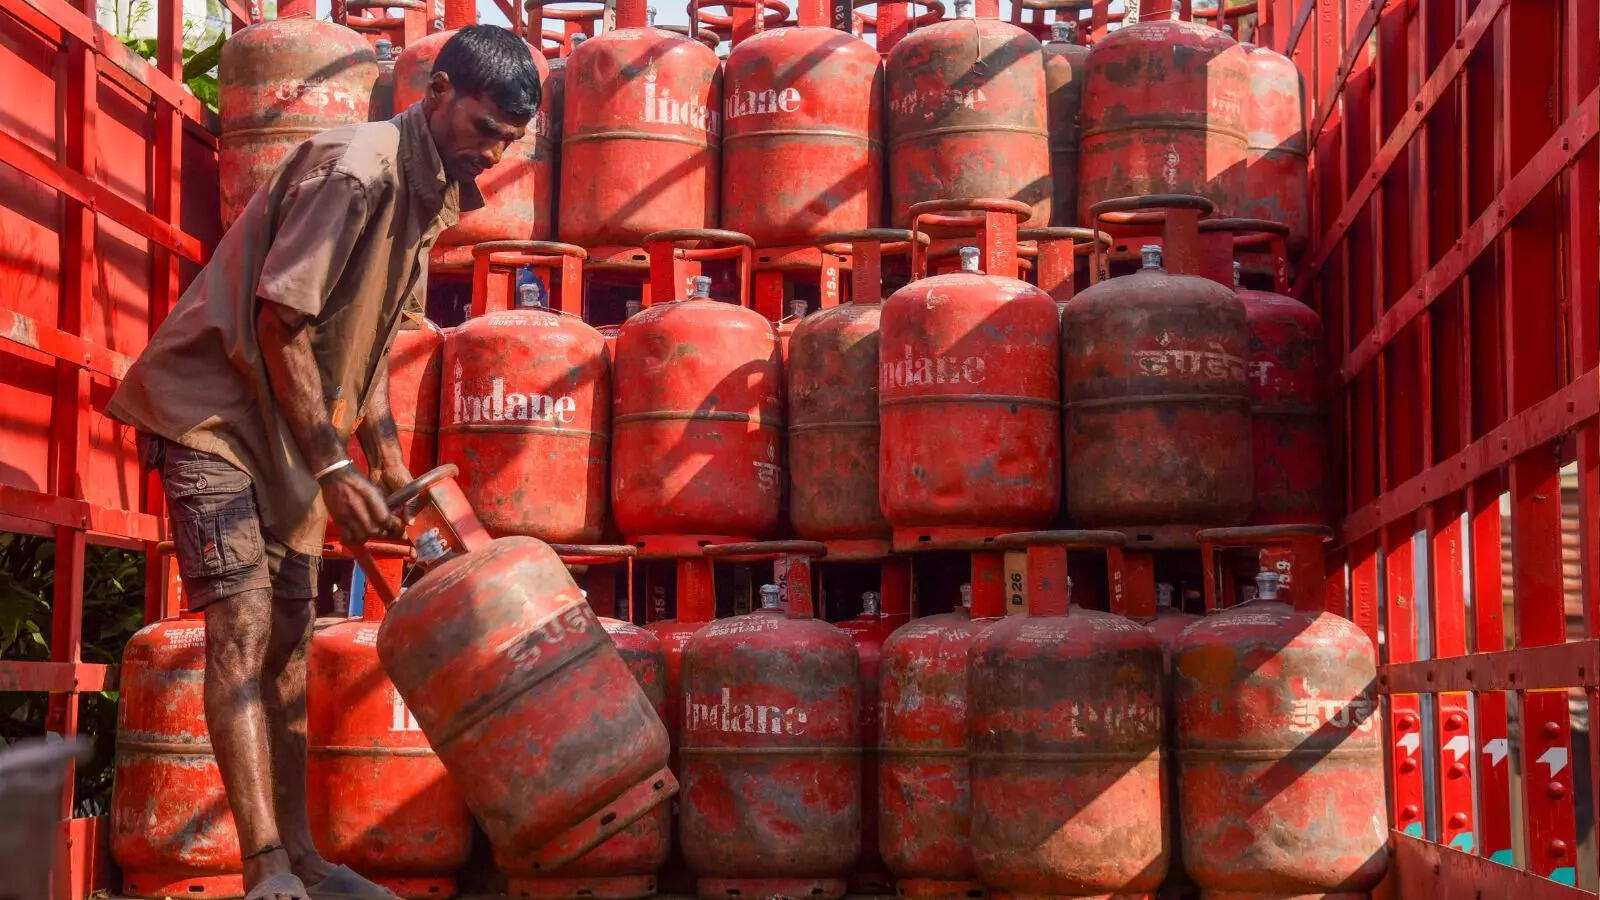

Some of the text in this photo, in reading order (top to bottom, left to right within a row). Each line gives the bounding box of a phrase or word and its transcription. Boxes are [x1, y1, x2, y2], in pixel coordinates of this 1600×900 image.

[881, 344, 985, 388] ndane
[453, 379, 576, 424] Indane
[1011, 573, 1022, 592] 26
[685, 688, 808, 735] Indane
